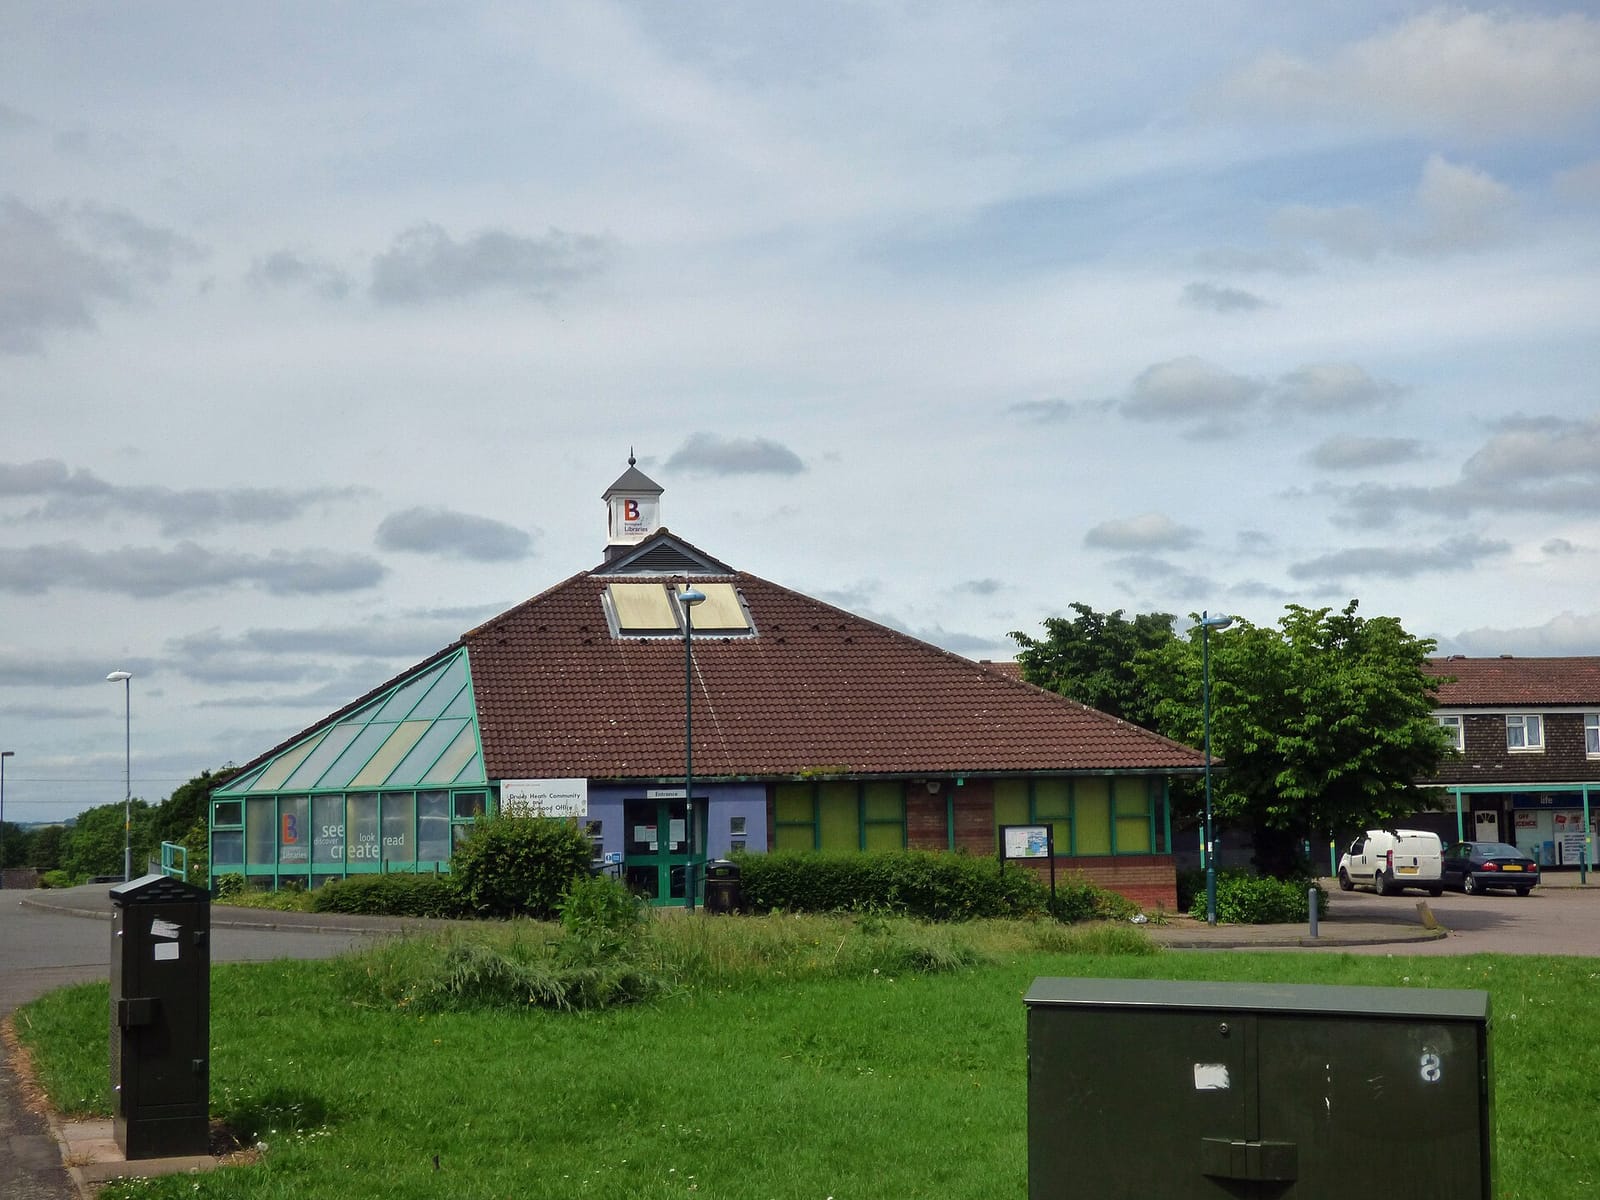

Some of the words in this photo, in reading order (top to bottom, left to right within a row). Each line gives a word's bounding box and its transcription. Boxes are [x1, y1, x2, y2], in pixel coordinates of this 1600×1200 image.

[625, 499, 640, 521] B
[283, 814, 298, 844] B
[322, 824, 344, 838] see
[313, 837, 339, 846] discover
[359, 832, 375, 842] look
[382, 832, 405, 846] read
[330, 842, 379, 859] create
